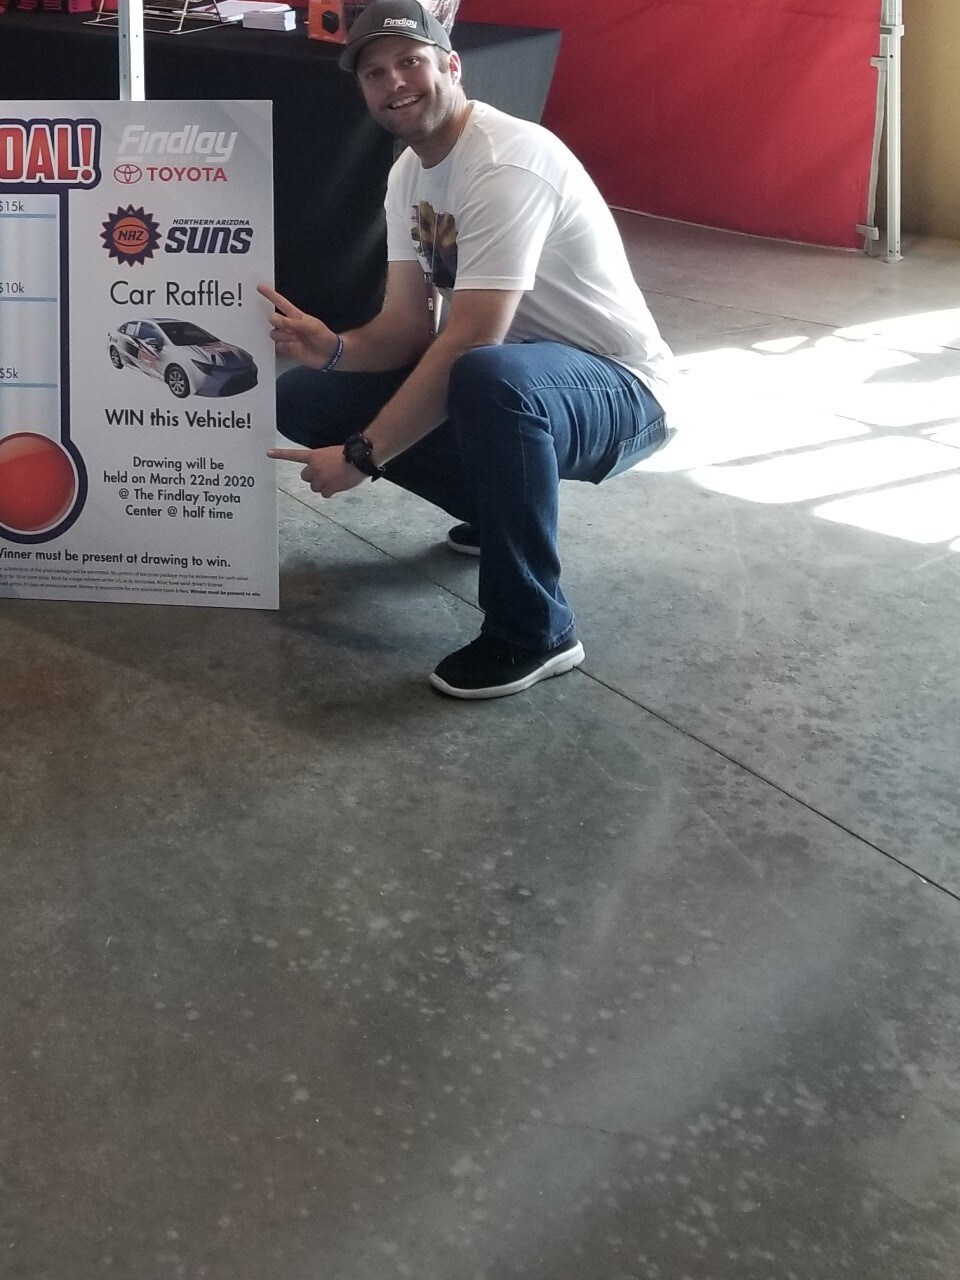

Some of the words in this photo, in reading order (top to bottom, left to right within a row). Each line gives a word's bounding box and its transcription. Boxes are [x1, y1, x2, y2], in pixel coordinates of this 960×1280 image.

[383, 18, 418, 29] Findlay
[118, 125, 237, 162] Findlay
[146, 167, 227, 181] TOYOTA
[110, 280, 156, 306] Car
[166, 280, 242, 307] Raffle!
[0, 368, 19, 380] $5k
[105, 409, 144, 426] WIN
[150, 408, 179, 427] this
[185, 409, 251, 429] Vehicle!
[133, 456, 182, 472] Drawing
[185, 457, 206, 470] will
[210, 458, 224, 470] be
[103, 470, 128, 483] held
[131, 475, 146, 484] on
[150, 473, 186, 485] March
[190, 474, 220, 486] 22nd
[224, 476, 255, 488] 2020
[118, 488, 130, 499] @
[134, 487, 154, 500] The
[157, 489, 199, 504] Findlay
[203, 491, 241, 506] Toyota
[125, 505, 162, 517] Center
[167, 506, 178, 517] @
[183, 505, 206, 518] half
[209, 508, 234, 519] time
[35, 550, 62, 561] must
[64, 549, 79, 561] be
[82, 552, 123, 565] present
[126, 554, 139, 564] at
[141, 552, 189, 568] drawing
[192, 556, 203, 566] to
[206, 556, 231, 567] win.
